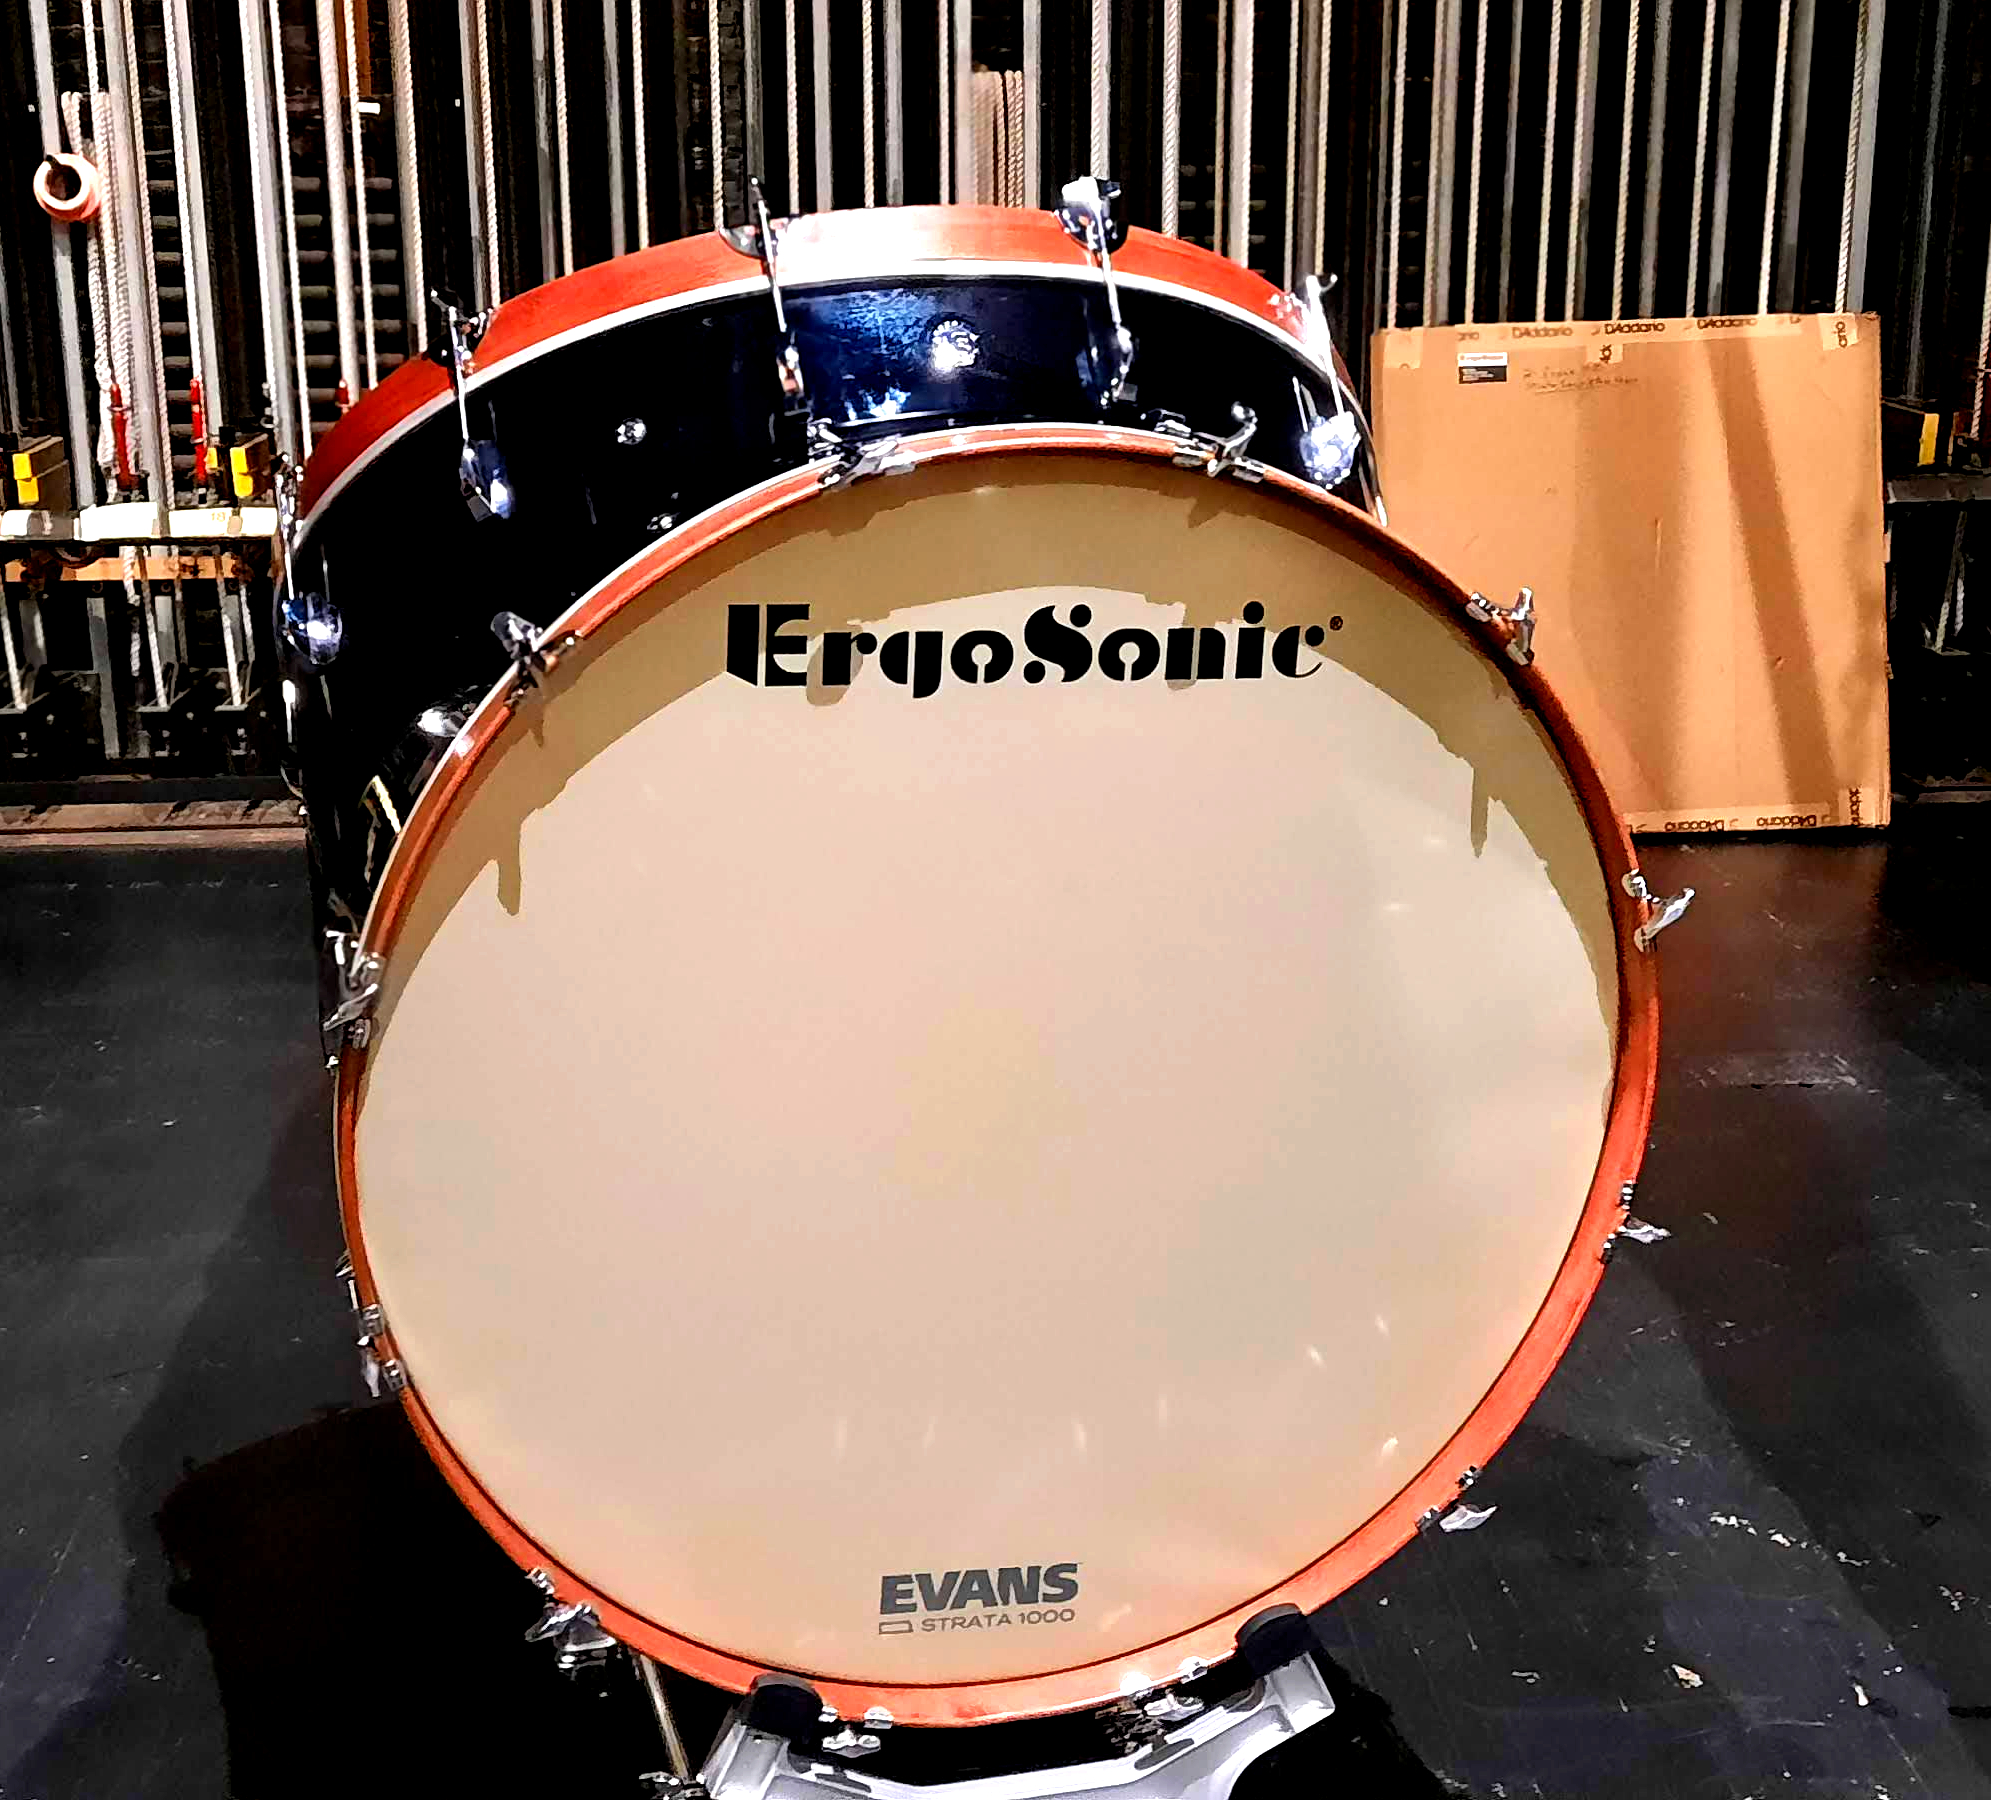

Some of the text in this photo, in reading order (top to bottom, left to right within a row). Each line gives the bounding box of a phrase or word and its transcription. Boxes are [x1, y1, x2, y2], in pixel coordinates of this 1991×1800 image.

[727, 601, 1324, 698] ErgoSonic
[879, 1563, 1079, 1614] EVANS
[921, 1608, 1075, 1632] STRATA 1000
